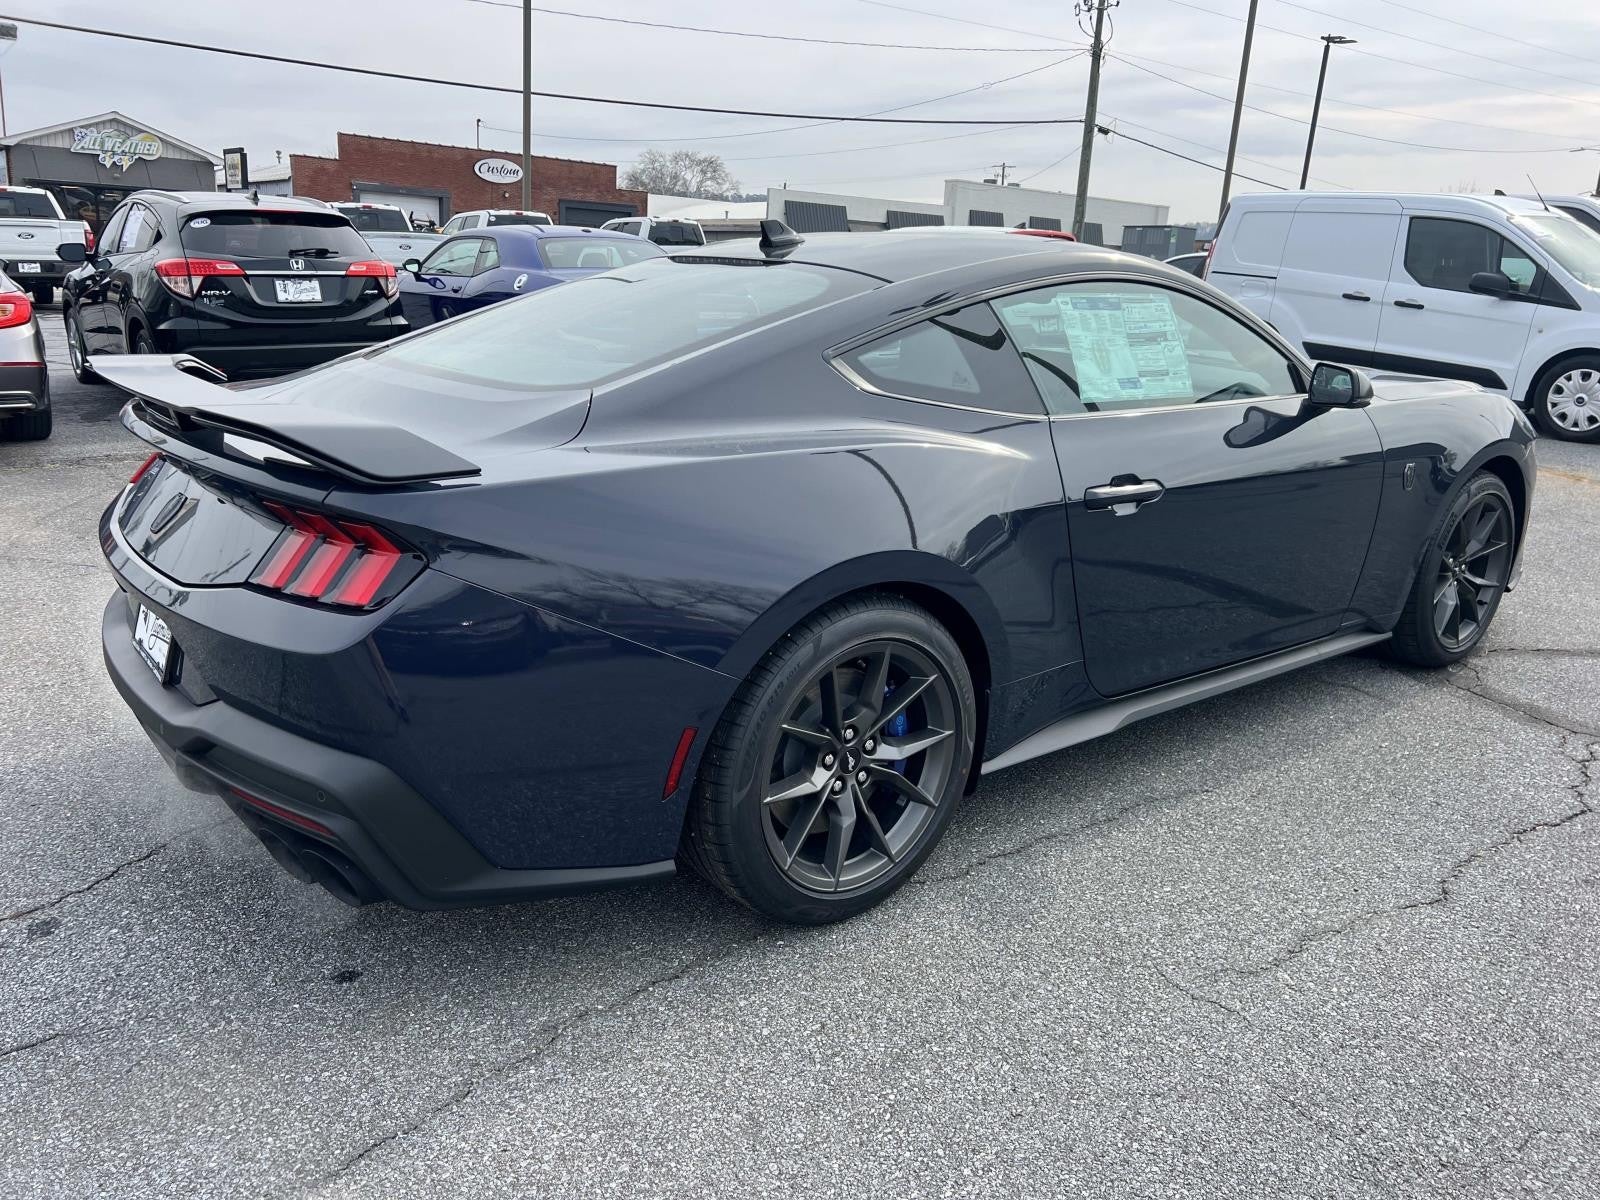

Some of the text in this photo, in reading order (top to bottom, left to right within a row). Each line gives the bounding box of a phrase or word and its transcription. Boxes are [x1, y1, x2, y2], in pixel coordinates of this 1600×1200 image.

[79, 135, 158, 155] ALL WEATHER
[478, 162, 519, 177] Custom
